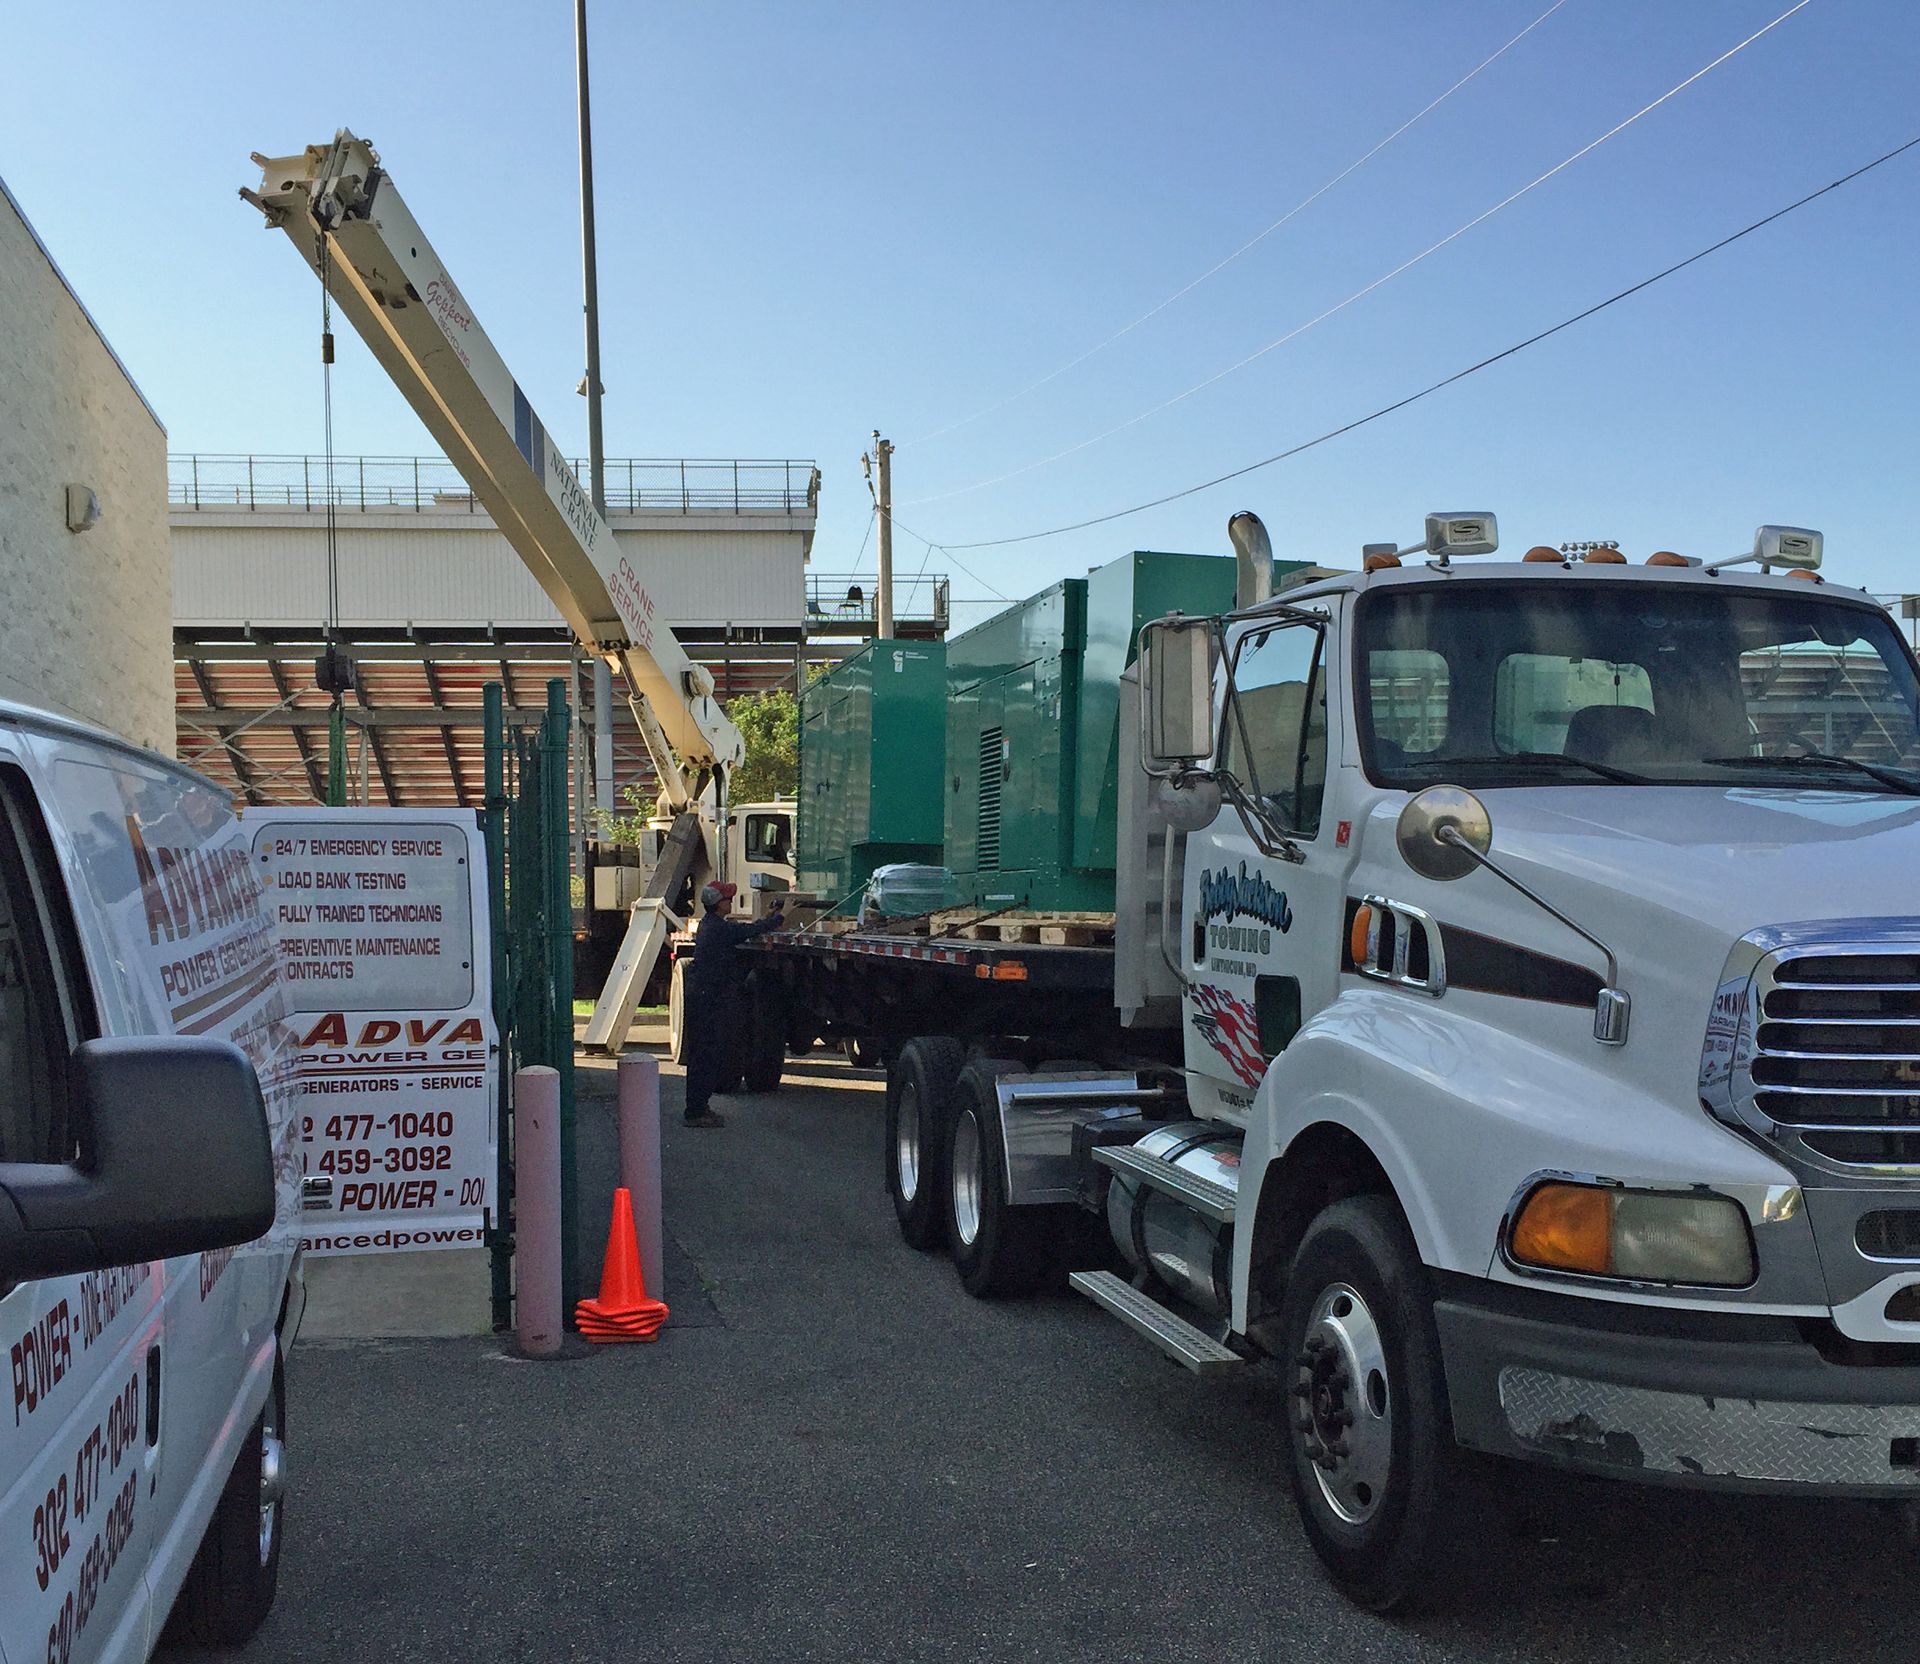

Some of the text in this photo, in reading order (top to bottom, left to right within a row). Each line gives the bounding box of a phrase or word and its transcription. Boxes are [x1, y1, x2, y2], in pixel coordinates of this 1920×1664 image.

[426, 280, 471, 332] Geppert
[438, 315, 471, 368] RECYCLING
[551, 452, 598, 536] NATIONAL
[560, 491, 597, 551] CRANE
[619, 557, 655, 621] CRANE
[609, 573, 654, 650] SERVICE
[275, 839, 442, 857] 24/7 EMERGENCY SERVICE
[278, 871, 406, 890] LOAD BANK TESTING
[279, 904, 442, 923] FULLY TRAINED TECHNICIANS
[280, 938, 441, 957] PREVENTIVE MAINTENANCE
[1210, 924, 1271, 955] TOWING
[160, 949, 220, 1002] POWER
[286, 961, 354, 980] ONTRACTS
[300, 1013, 484, 1048] ADVA
[301, 1052, 428, 1064] POWER
[301, 1079, 399, 1094] GENERATORS
[421, 1076, 483, 1089] SERVICE
[325, 1111, 453, 1141] 477-1040
[319, 1145, 451, 1175] 459-3092
[339, 1180, 437, 1211] POWER
[460, 1177, 485, 1206] DO
[10, 1298, 72, 1428] POWER
[33, 1372, 139, 1592] 302 477-1040
[75, 1468, 137, 1641] 459-3092
